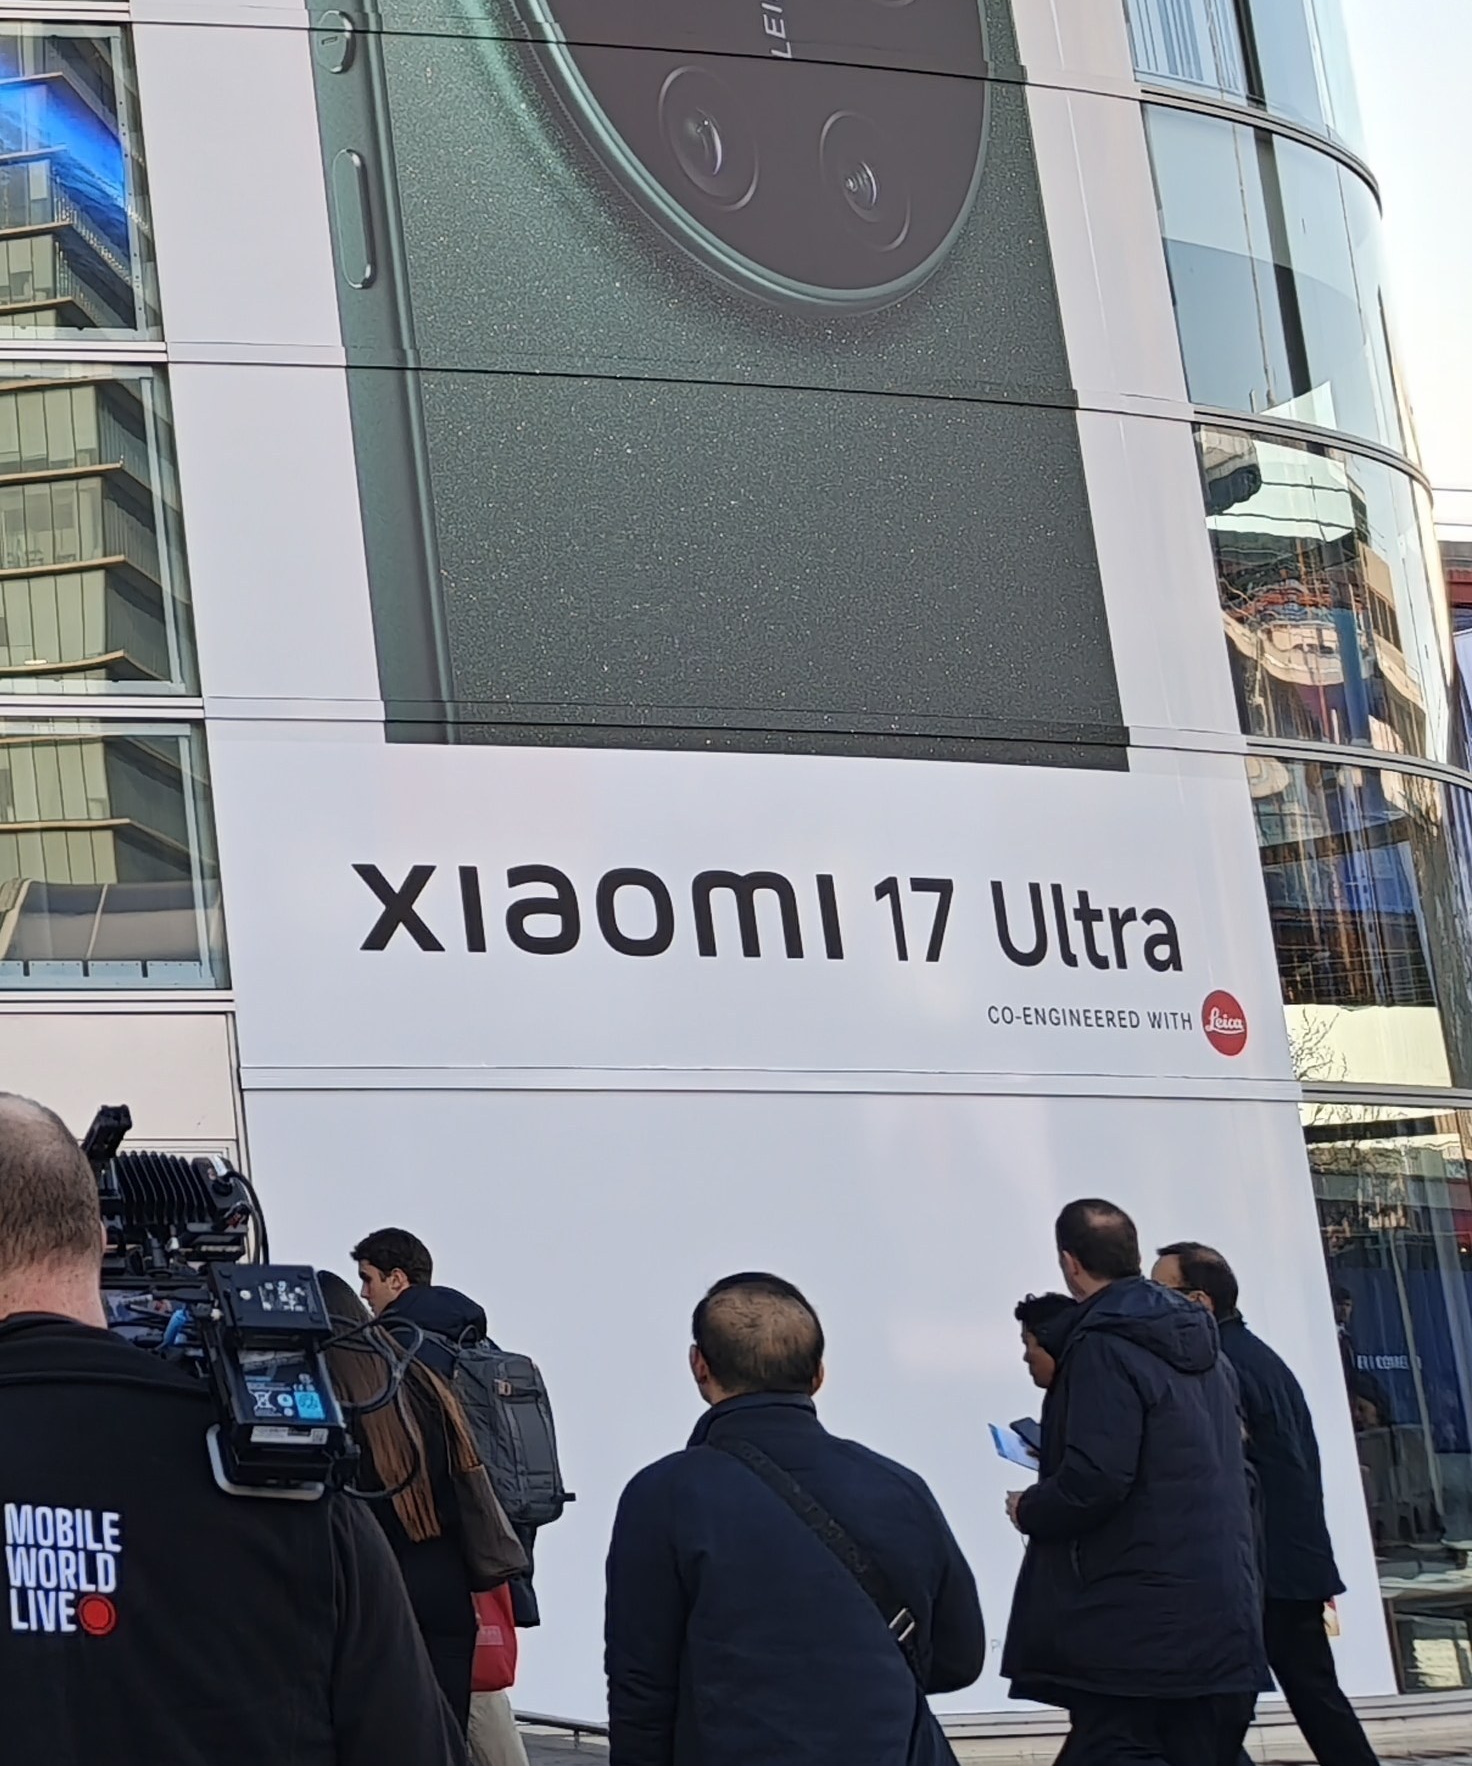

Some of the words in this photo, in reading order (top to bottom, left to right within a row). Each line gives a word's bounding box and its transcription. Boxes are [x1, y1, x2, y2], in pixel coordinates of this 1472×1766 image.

[874, 876, 954, 963] 17
[990, 880, 1184, 973] Ultra
[986, 1005, 1140, 1029] CO-ENGINEERED
[1146, 1011, 1194, 1031] WITH
[1204, 1005, 1245, 1035] Leica
[4, 1502, 122, 1553] MOBILE
[5, 1545, 118, 1594] WORLD
[9, 1587, 78, 1632] LIVE
